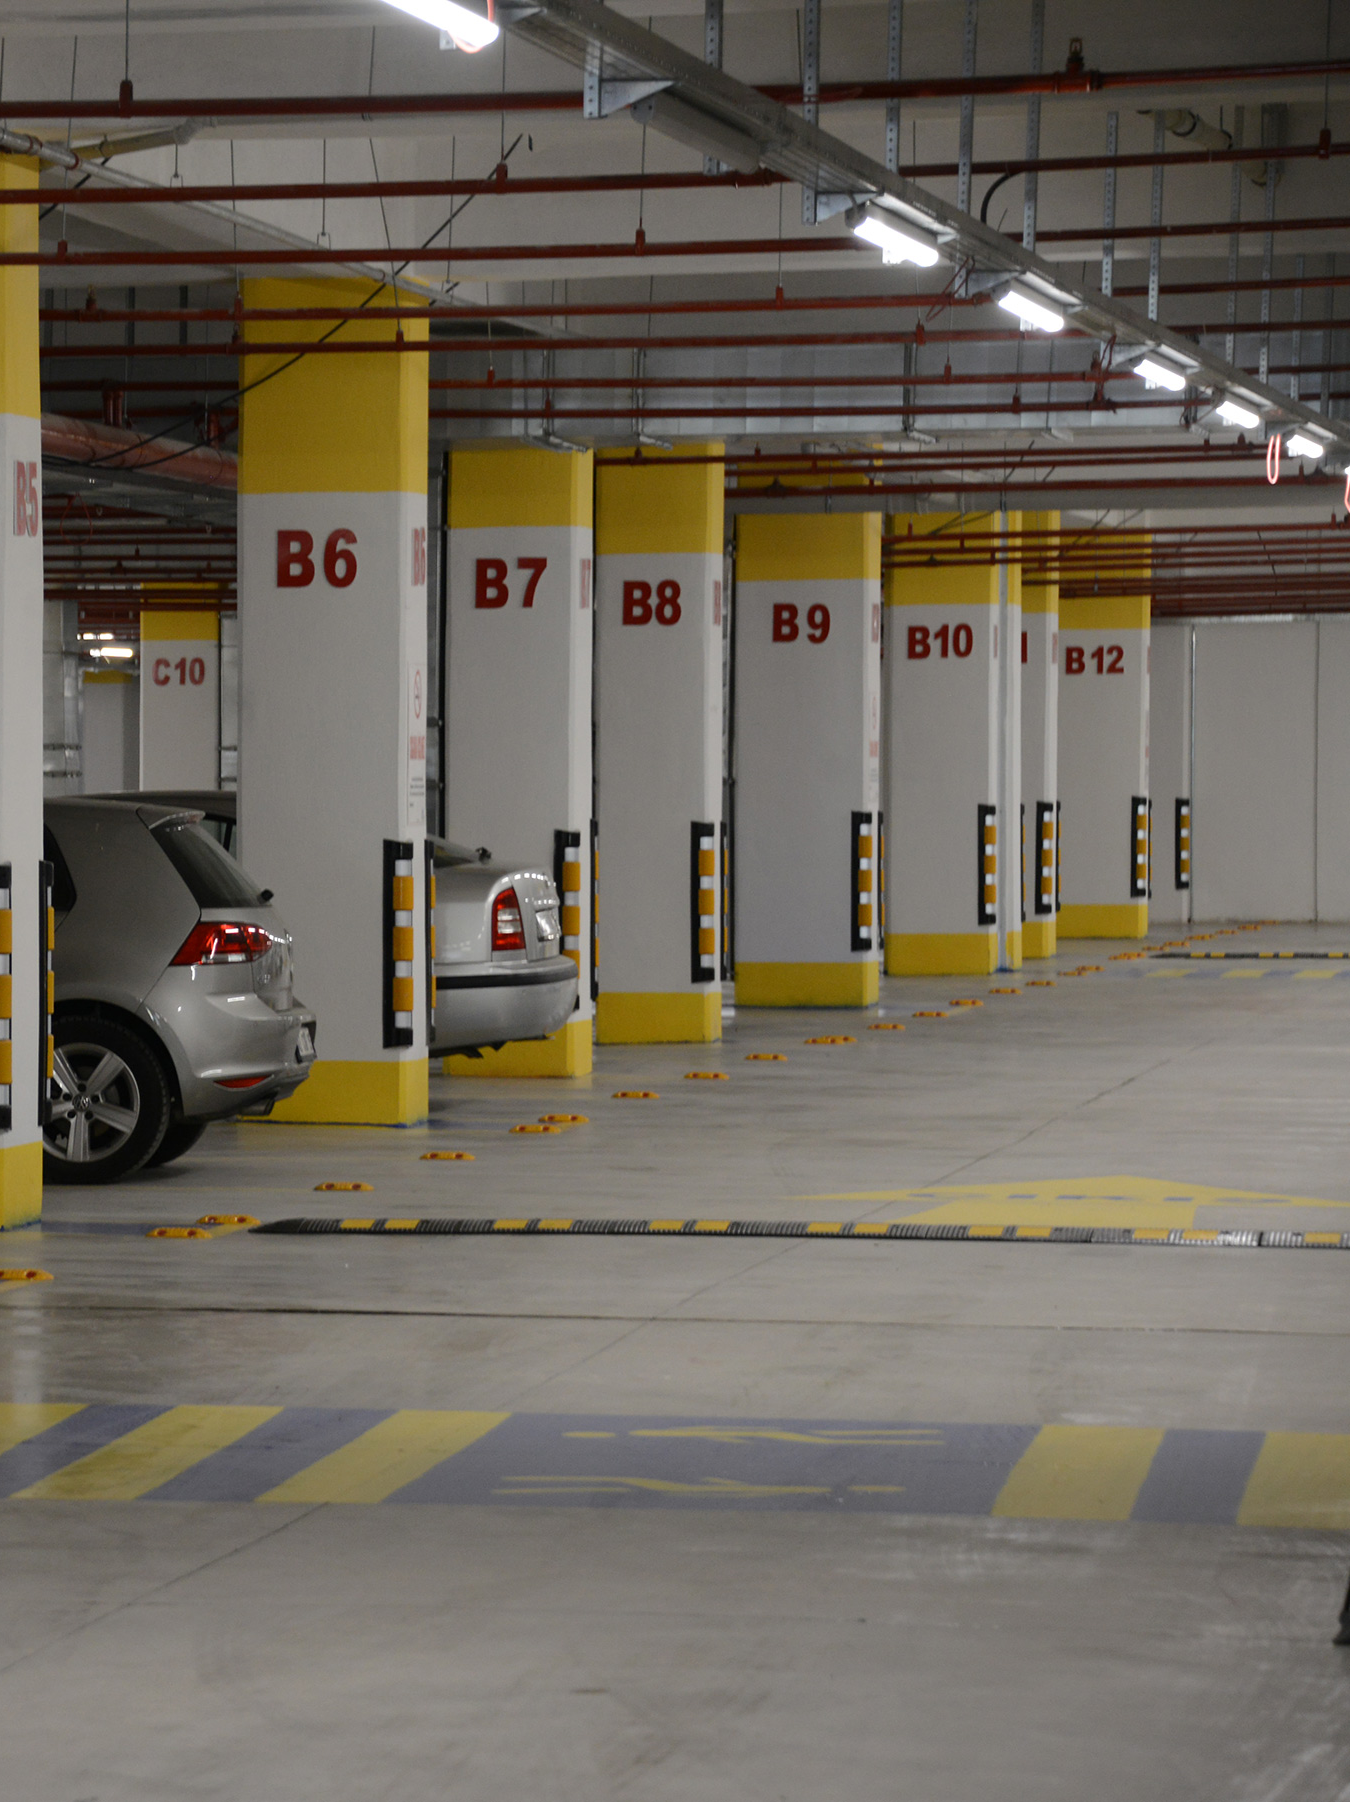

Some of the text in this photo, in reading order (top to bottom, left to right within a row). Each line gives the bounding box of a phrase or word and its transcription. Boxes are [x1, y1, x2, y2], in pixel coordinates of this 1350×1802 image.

[13, 460, 39, 537] B5
[276, 527, 358, 588] B6
[474, 556, 548, 609] B7
[622, 579, 682, 626] B8
[771, 602, 831, 645] B9
[906, 622, 974, 660] B10
[151, 656, 206, 687] C10
[1064, 644, 1125, 676] B12
